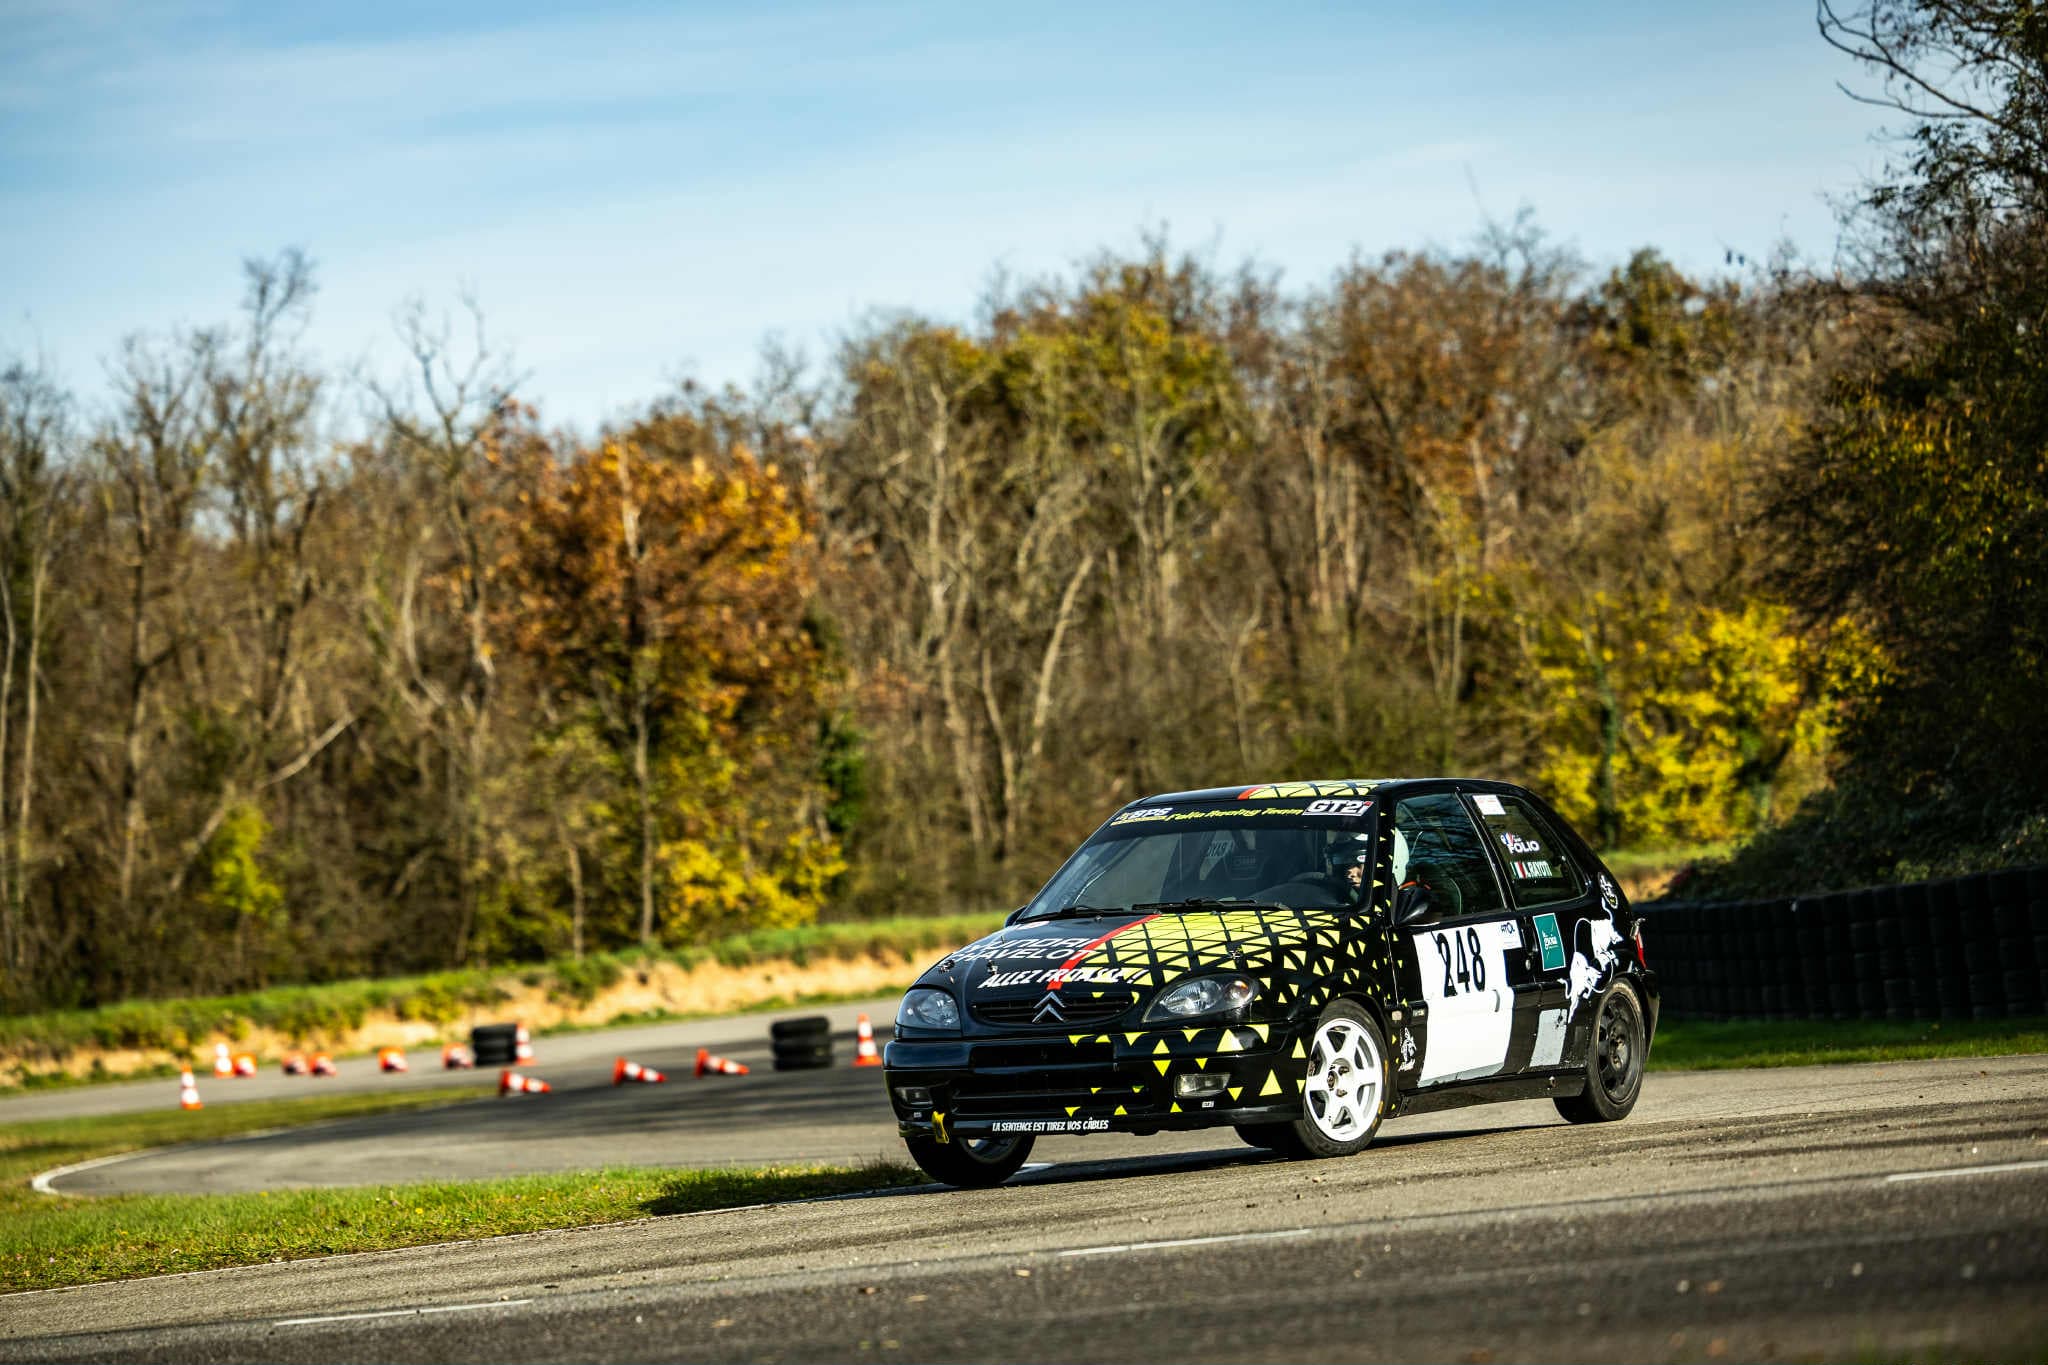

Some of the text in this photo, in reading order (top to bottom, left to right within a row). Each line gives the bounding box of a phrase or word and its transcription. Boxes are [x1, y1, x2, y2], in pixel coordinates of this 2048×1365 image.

[1507, 840, 1540, 854] FOLIO
[1435, 927, 1486, 997] 248
[977, 970, 1043, 988] ALLEZ
[992, 1116, 1109, 1131] LA SENTENCE EST TIREZ VOS CÂBLES
